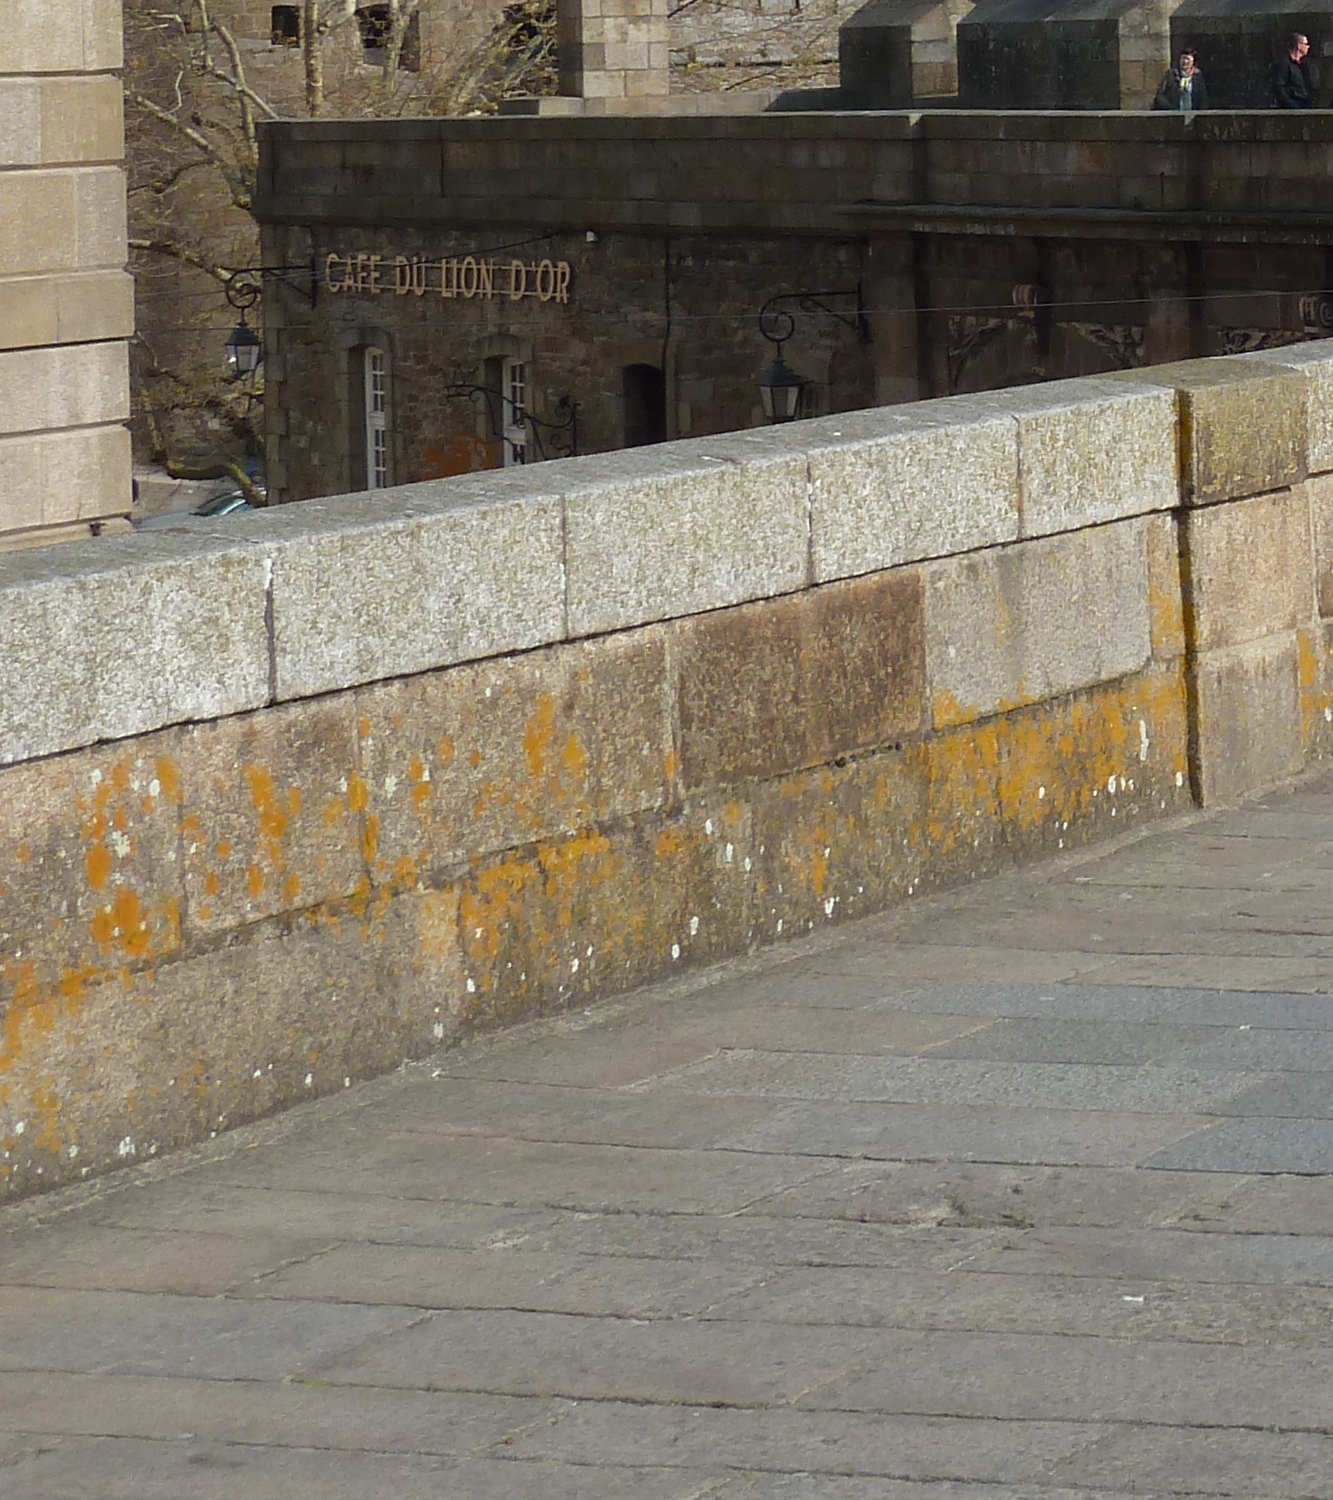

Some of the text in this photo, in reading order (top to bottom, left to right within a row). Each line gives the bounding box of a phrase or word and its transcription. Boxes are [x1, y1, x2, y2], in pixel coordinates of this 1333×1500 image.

[325, 253, 570, 303] CAFE DU LION D'OR
